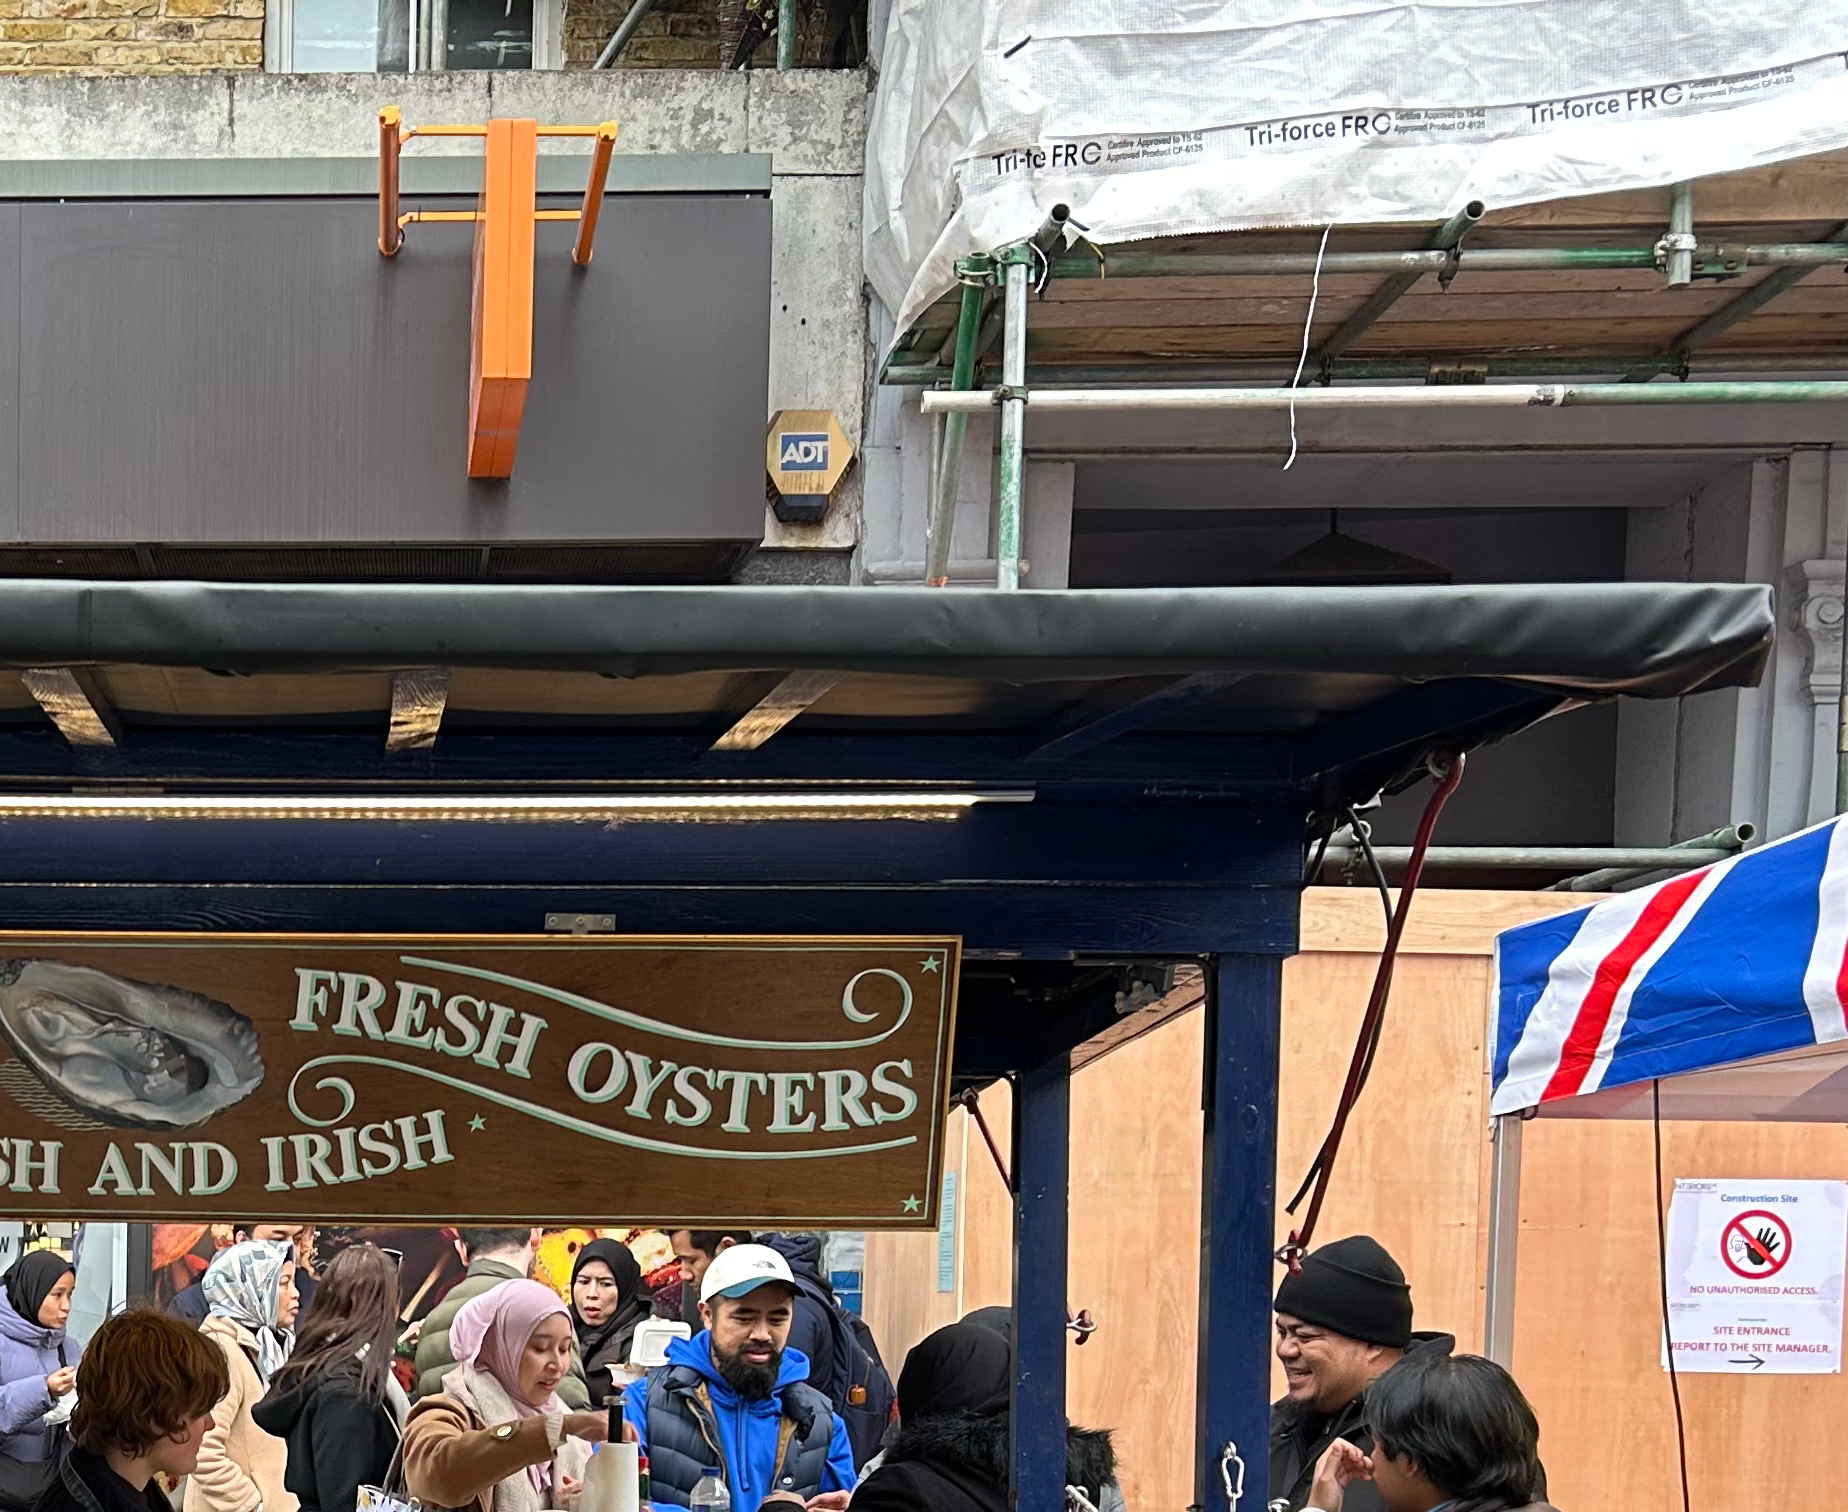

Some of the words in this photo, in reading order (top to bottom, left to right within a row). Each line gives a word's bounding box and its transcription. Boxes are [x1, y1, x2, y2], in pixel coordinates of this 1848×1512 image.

[1527, 98, 1620, 124] Tri-force
[1245, 121, 1336, 146] Tri-force
[781, 440, 829, 464] ADT
[288, 966, 549, 1080] FRESH
[567, 1040, 919, 1134] OYSTERS
[88, 1141, 239, 1197] AND
[260, 1108, 455, 1193] IRISH
[1720, 1194, 1779, 1203] Construction
[1780, 1194, 1798, 1203] Site
[1690, 1285, 1704, 1294] NO
[1707, 1285, 1781, 1295] UNAUTHORISED
[1713, 1326, 1734, 1335] SITE
[1737, 1327, 1791, 1336] ENTRANCE
[1670, 1342, 1710, 1351] REPORT
[1714, 1343, 1727, 1351] TO
[1730, 1343, 1749, 1351] THE
[1752, 1343, 1772, 1352] SITE
